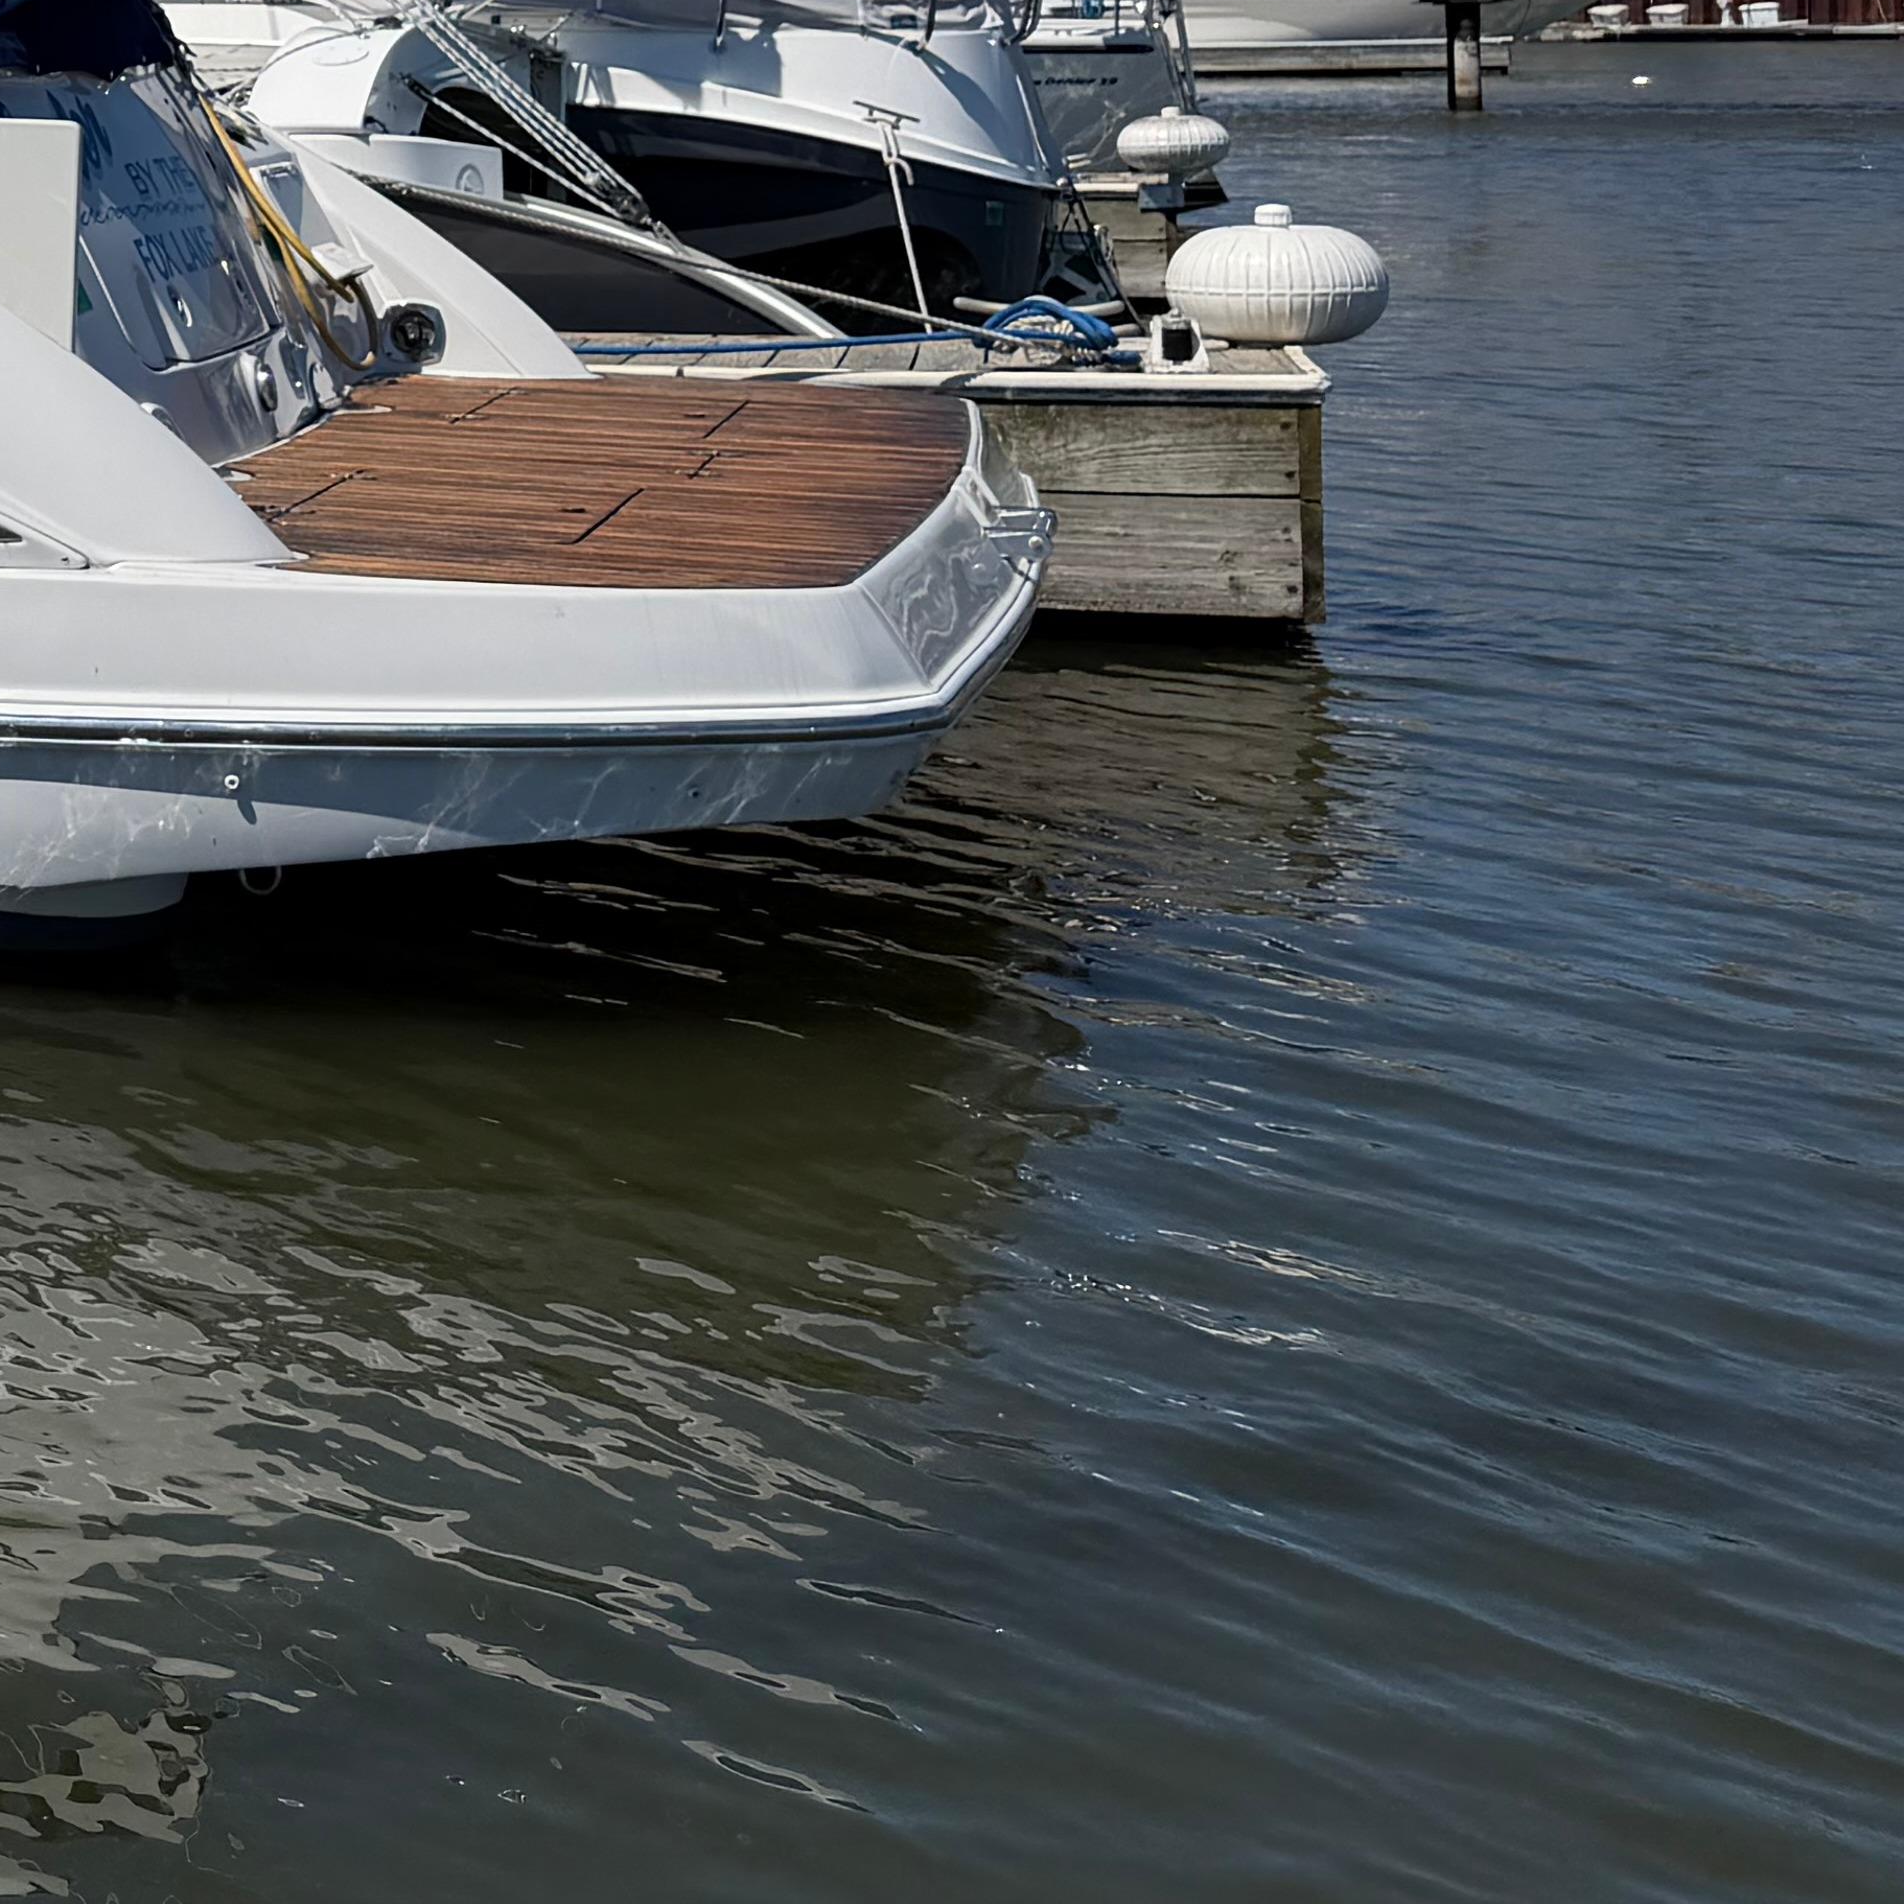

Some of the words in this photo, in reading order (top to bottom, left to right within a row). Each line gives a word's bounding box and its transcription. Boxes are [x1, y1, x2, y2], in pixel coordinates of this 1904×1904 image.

[124, 160, 160, 195] BY
[153, 156, 195, 194] THE
[133, 232, 183, 284] FOX
